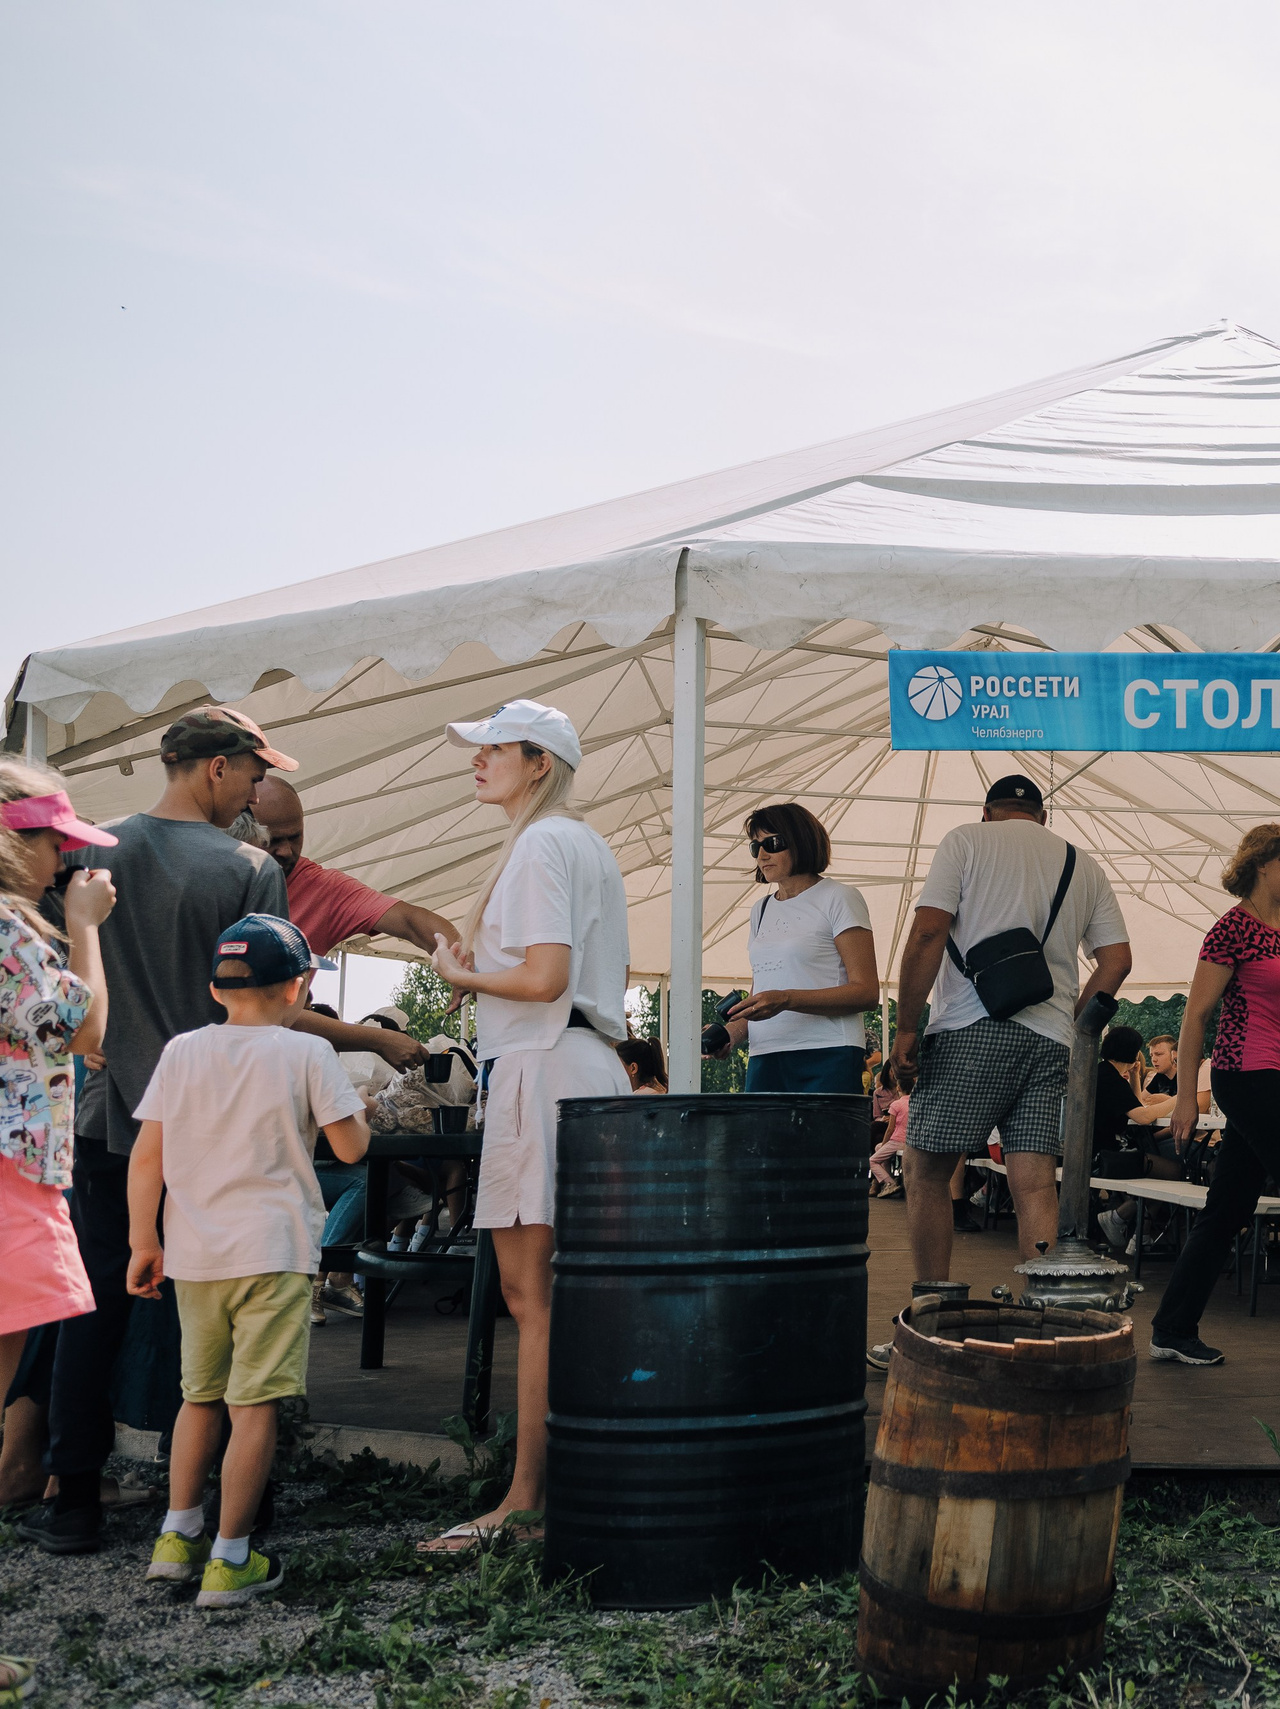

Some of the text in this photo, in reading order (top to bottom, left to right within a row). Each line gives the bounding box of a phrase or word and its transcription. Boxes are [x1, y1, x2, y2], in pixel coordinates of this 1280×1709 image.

[970, 675, 1080, 698] РОССЕТИ
[971, 704, 1009, 719] УРАЛ
[971, 726, 1044, 741] Челябэнерго
